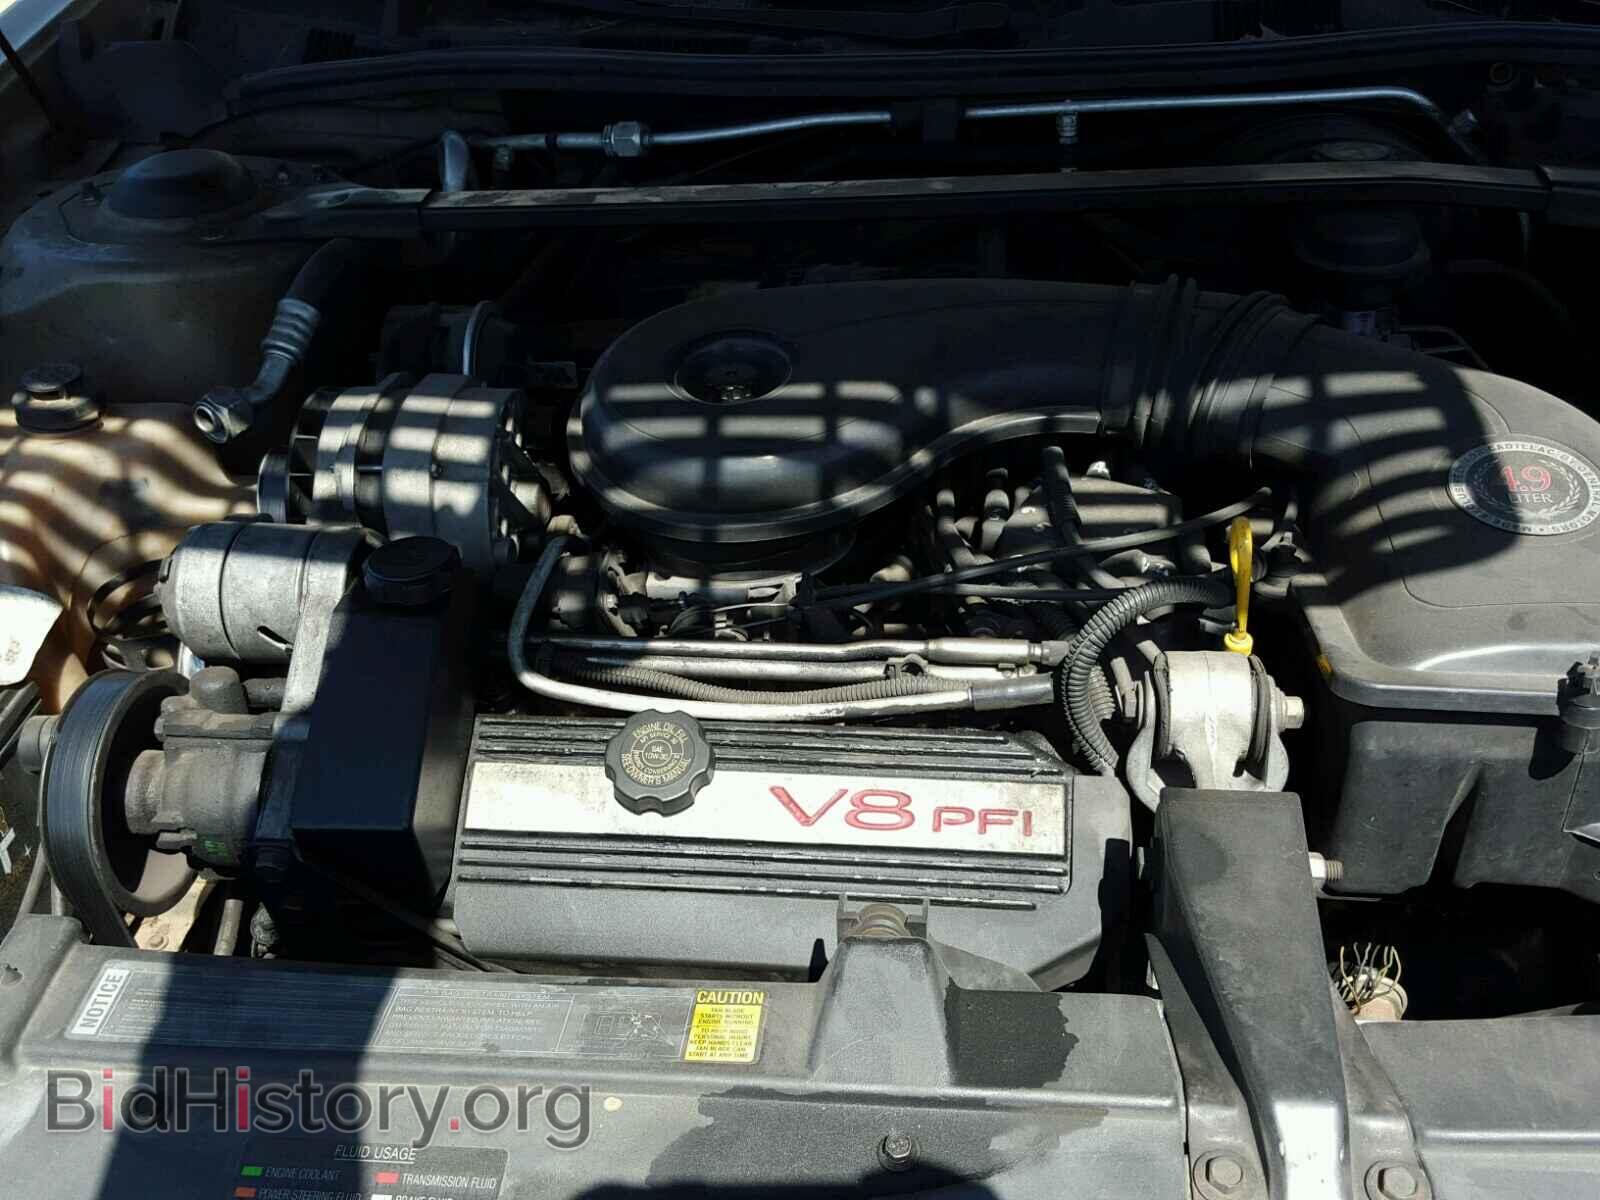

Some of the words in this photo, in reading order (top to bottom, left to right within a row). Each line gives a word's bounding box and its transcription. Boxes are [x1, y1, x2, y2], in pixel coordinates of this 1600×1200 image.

[769, 786, 915, 831] V8
[932, 806, 1033, 837] PFI
[79, 975, 123, 1028] NOTICE
[696, 990, 764, 1005] CAUTION
[334, 1145, 370, 1158] FLUID
[374, 1146, 417, 1160] USAGE
[265, 1167, 296, 1178] ENGINE
[298, 1168, 341, 1180] COOLANT
[402, 1173, 468, 1188] TRANSMISSION
[470, 1176, 497, 1189] FLUID
